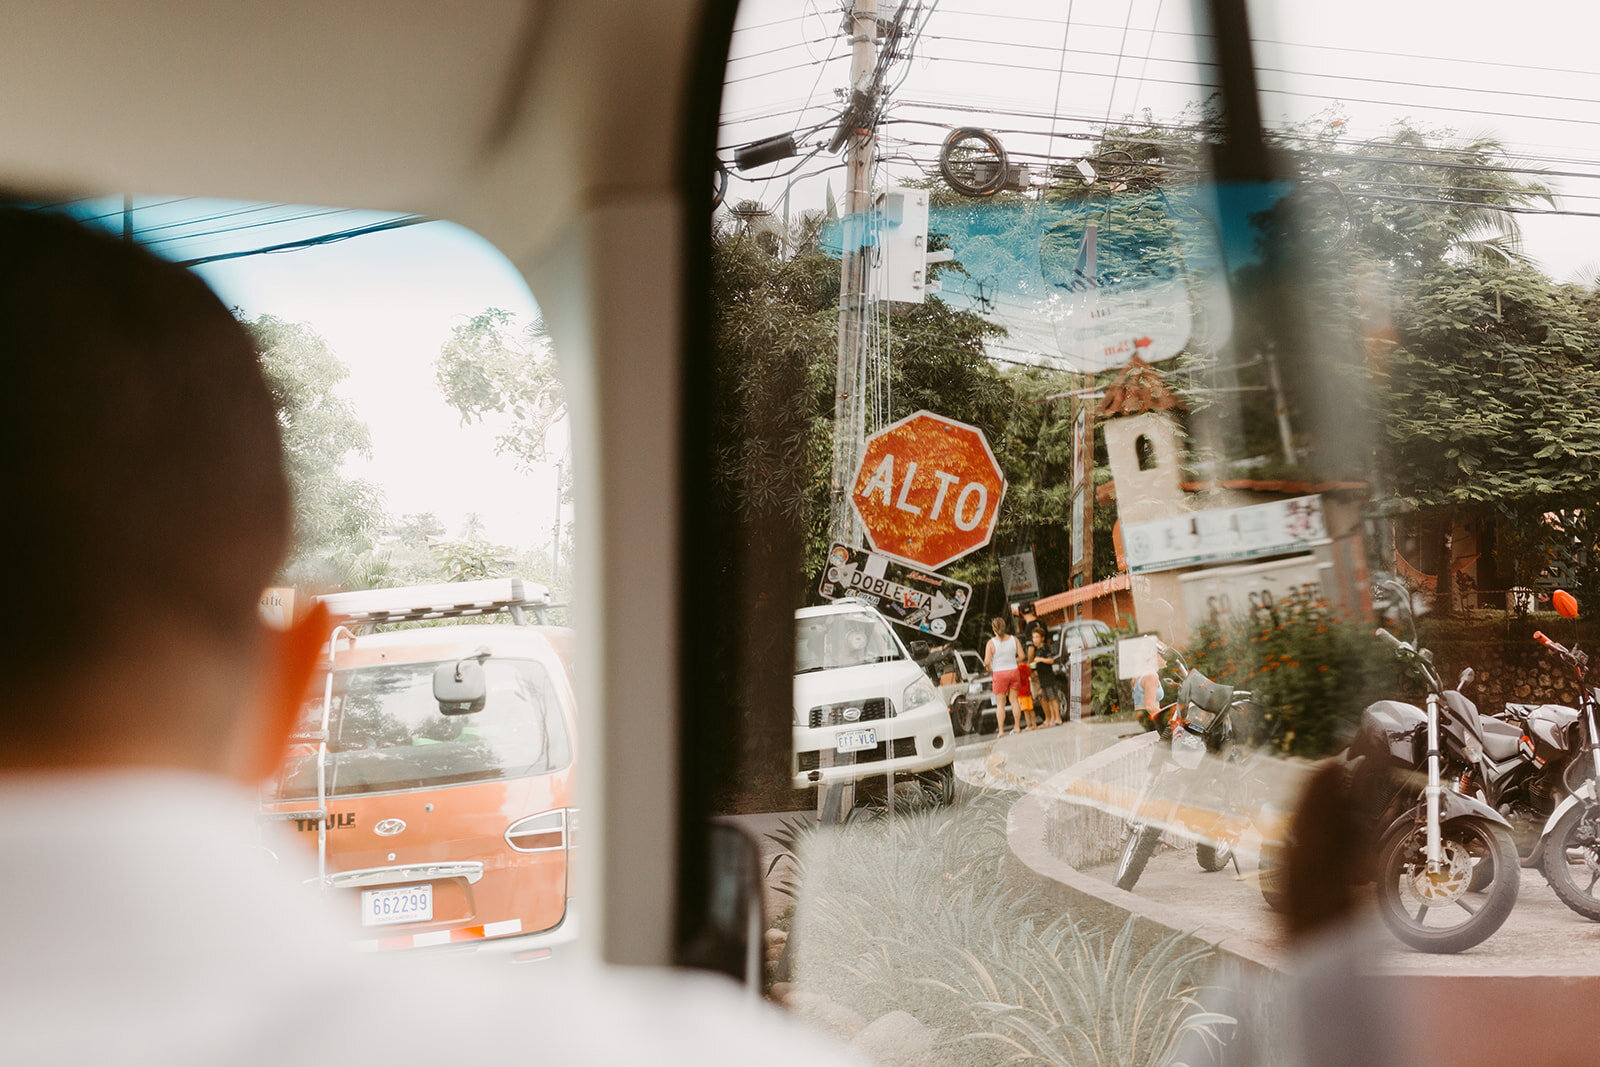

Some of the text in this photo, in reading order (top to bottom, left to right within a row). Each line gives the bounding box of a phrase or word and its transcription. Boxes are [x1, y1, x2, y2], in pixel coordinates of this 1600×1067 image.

[861, 453, 988, 532] ALTO
[850, 571, 904, 600] DOBLE
[295, 812, 356, 832] THULE
[373, 893, 427, 916] 662299
